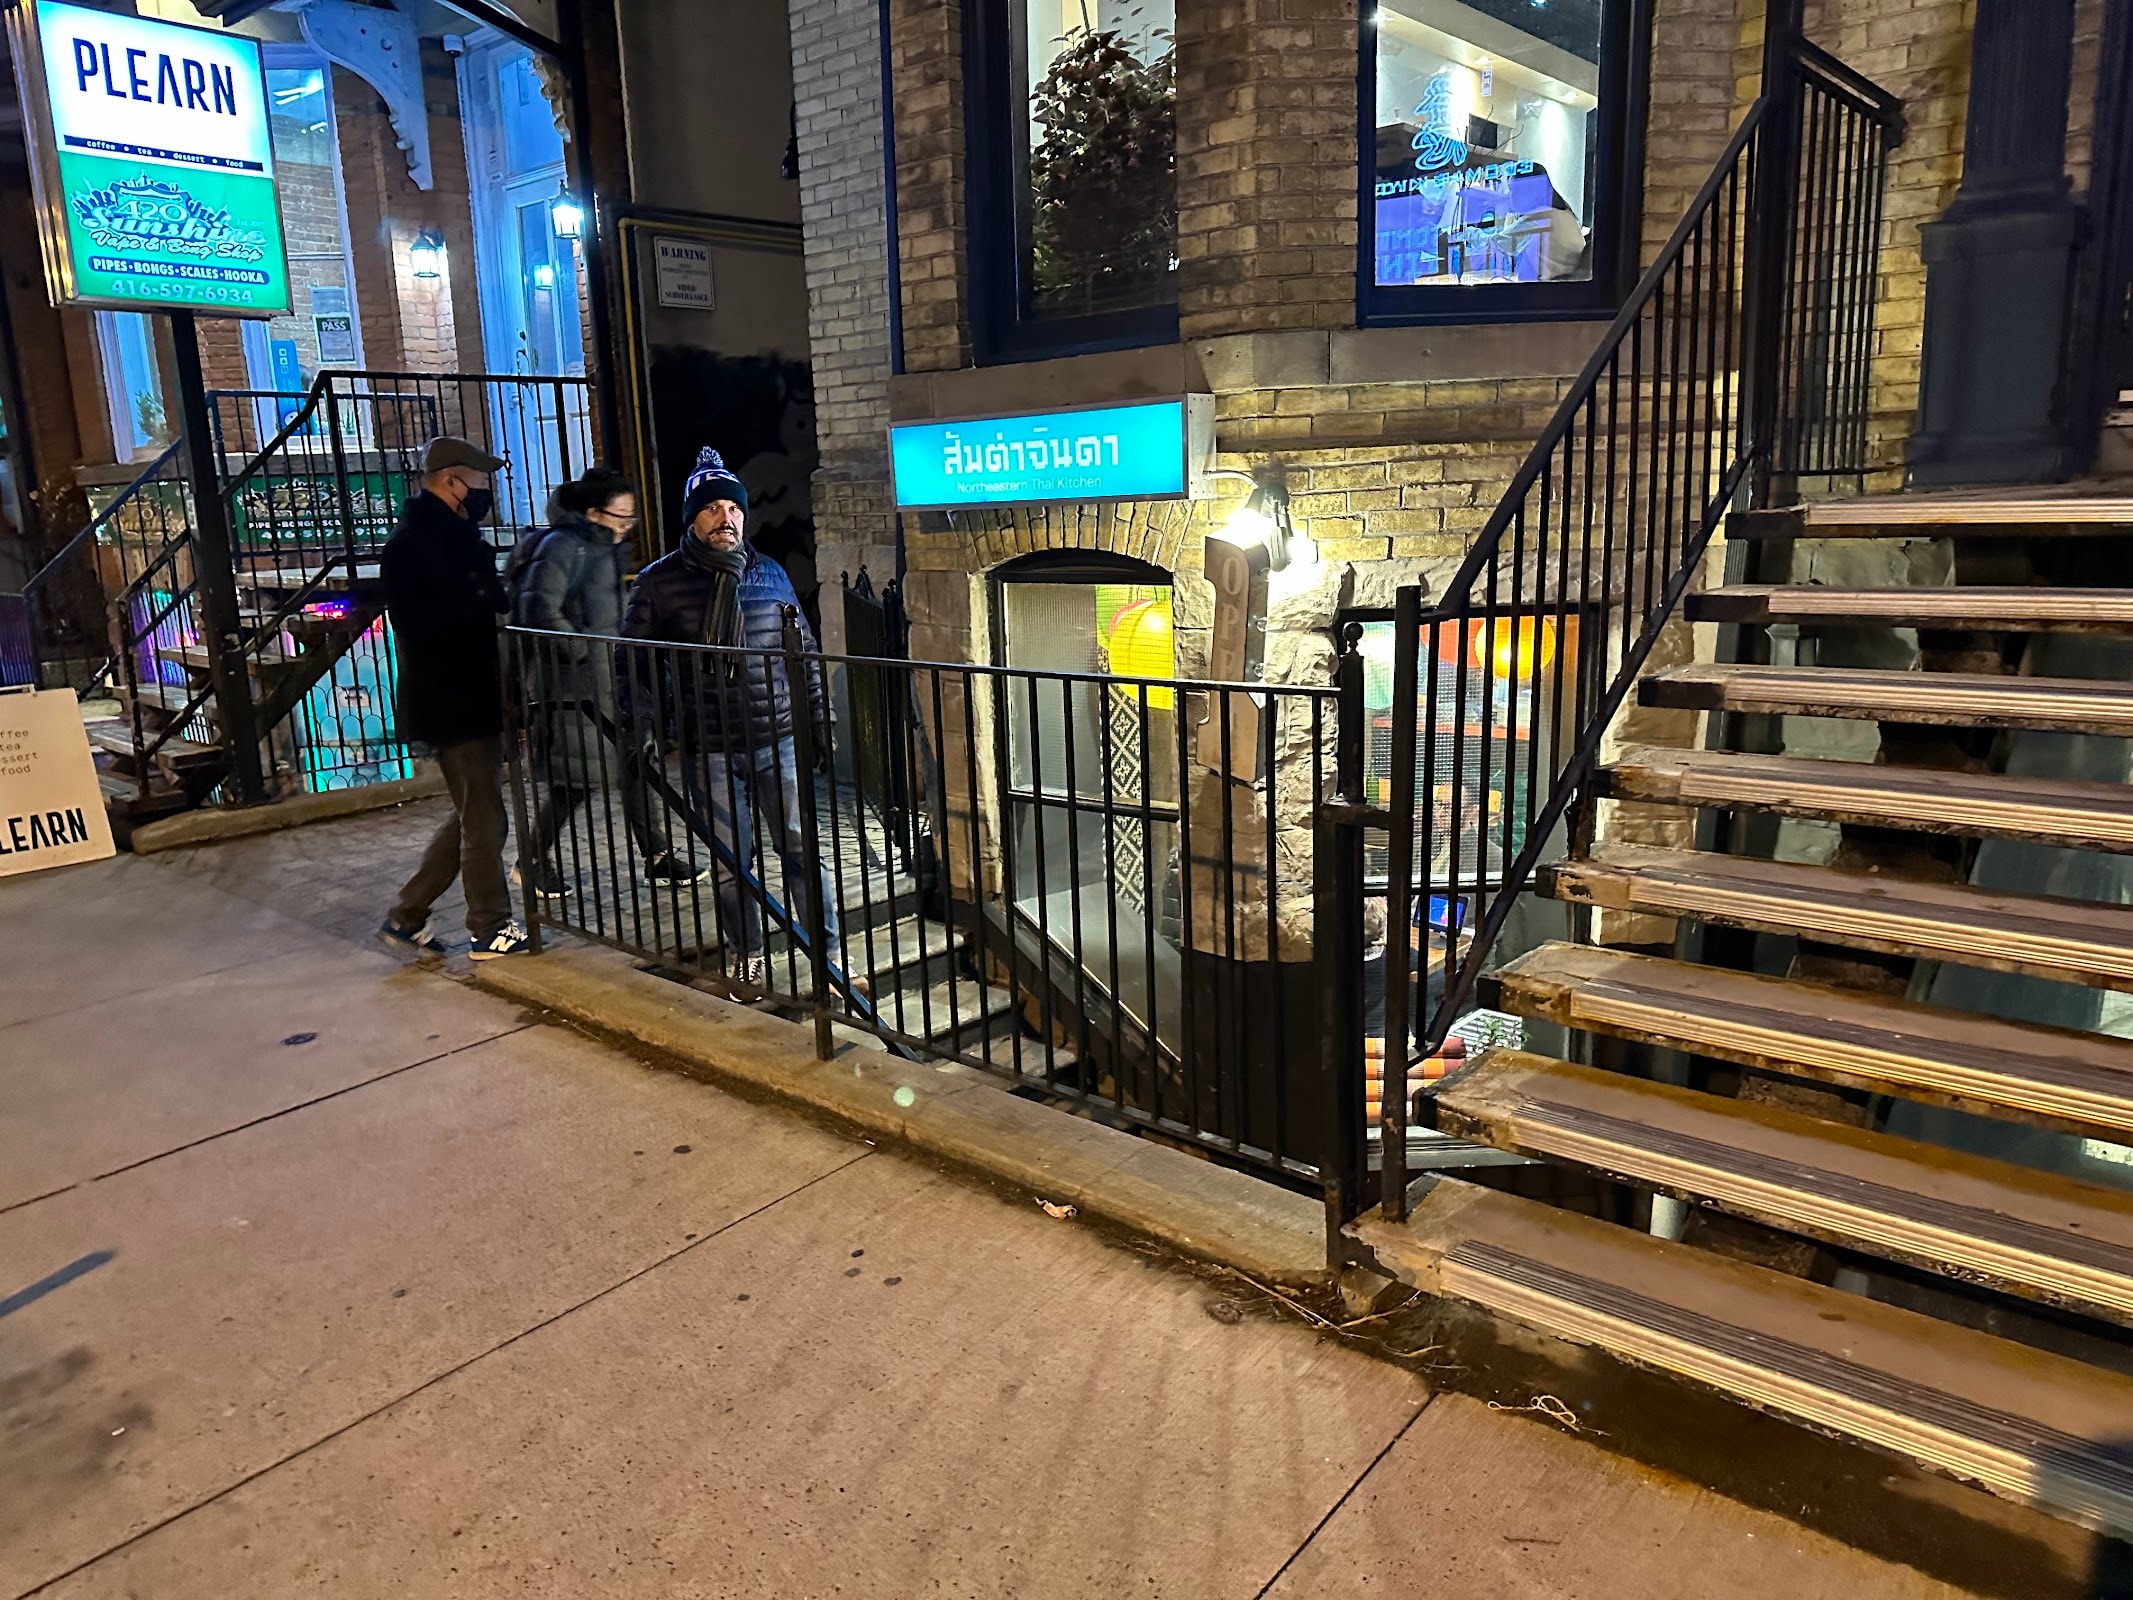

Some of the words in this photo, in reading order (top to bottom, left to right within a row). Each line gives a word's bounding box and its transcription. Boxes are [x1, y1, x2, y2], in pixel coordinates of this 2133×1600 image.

[72, 37, 237, 116] PLEARN
[86, 140, 116, 151] coffee
[137, 147, 152, 156] tea
[173, 152, 205, 164] dessert
[225, 159, 244, 168] food
[114, 200, 188, 222] 420
[80, 206, 267, 246] Sunshine
[91, 230, 141, 251] Vape
[144, 239, 160, 251] &
[167, 239, 213, 260] Bong
[215, 243, 264, 263] Shop
[660, 246, 706, 261] WARNING
[92, 257, 128, 272] PIPES
[134, 261, 175, 276] BONGS
[180, 266, 219, 280] SCALES
[224, 270, 265, 284] HOOKA
[111, 279, 254, 304] 416-597-6934
[321, 321, 347, 331] PASS
[957, 481, 1028, 493] Northeastern
[1031, 478, 1054, 490] Thai
[1057, 476, 1102, 488] Kitchen
[1217, 556, 1243, 735] OPE
[1, 764, 31, 776] food
